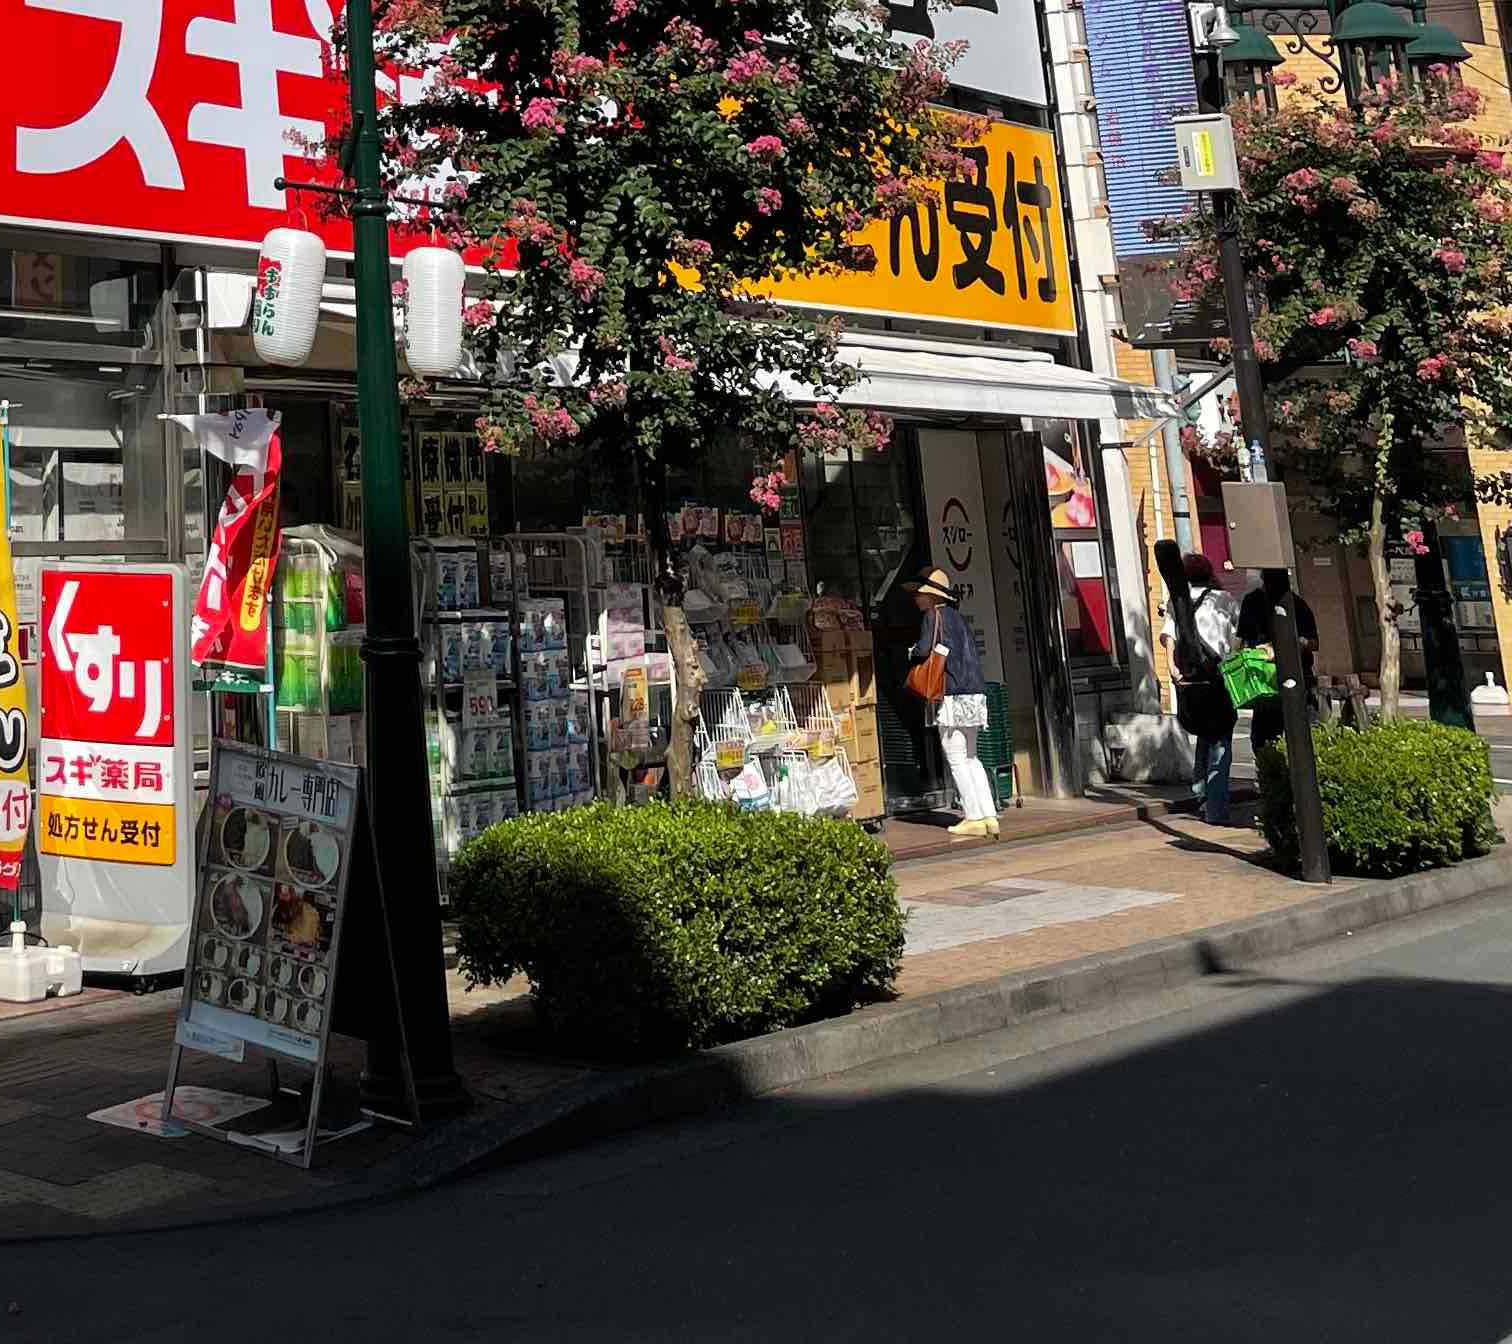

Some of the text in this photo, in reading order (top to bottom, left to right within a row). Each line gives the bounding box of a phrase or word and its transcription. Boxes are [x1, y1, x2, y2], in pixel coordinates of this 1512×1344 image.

[48, 580, 164, 737] くすり
[46, 752, 164, 792] スギ薬局
[47, 811, 162, 849] 処方せん受付
